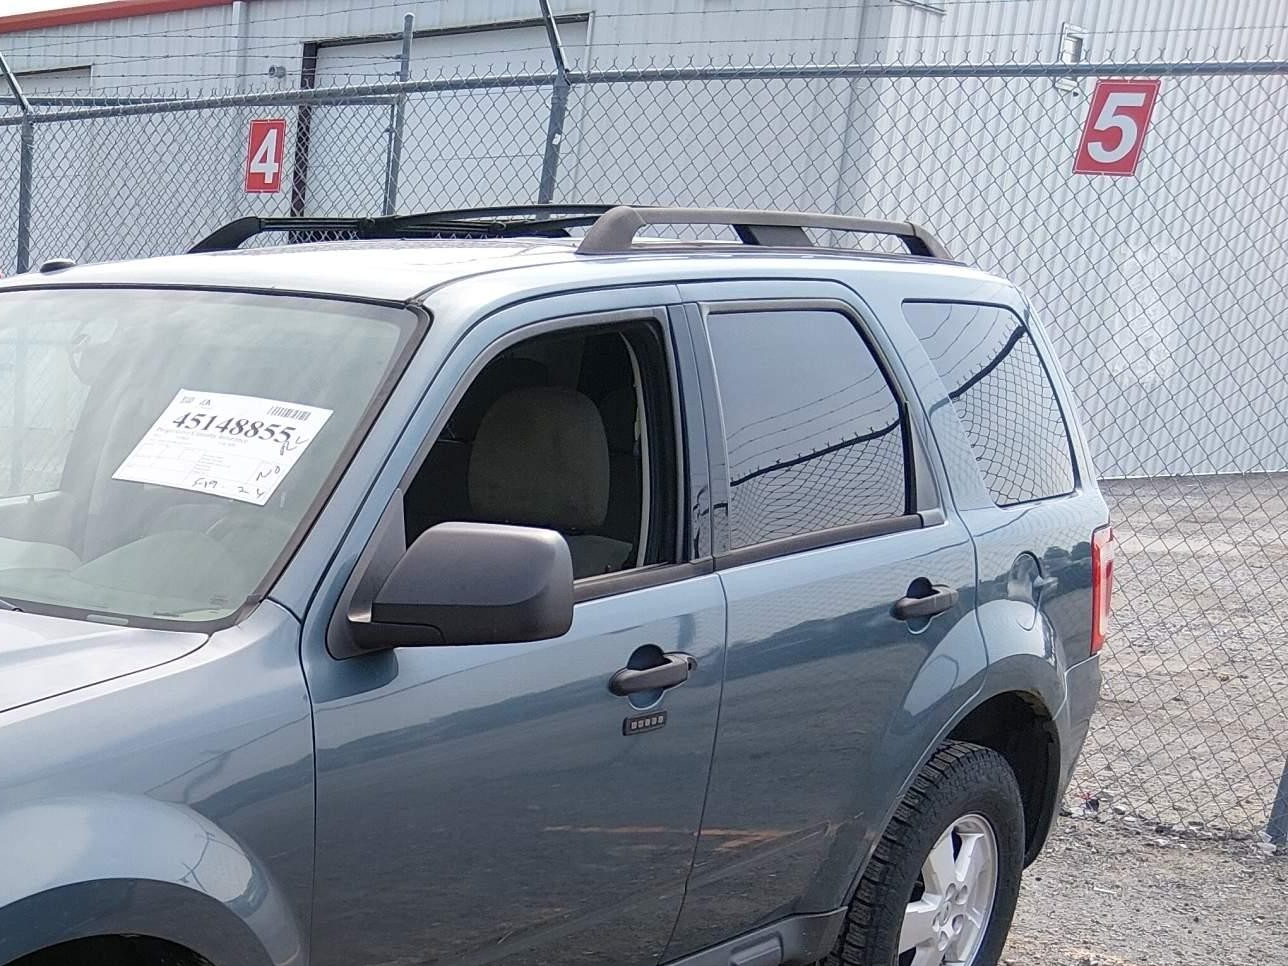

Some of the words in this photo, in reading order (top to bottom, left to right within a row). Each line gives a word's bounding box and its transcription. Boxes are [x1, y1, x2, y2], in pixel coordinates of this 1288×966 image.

[249, 128, 280, 184] 4
[1087, 92, 1146, 164] 5
[172, 411, 297, 443] 45148855
